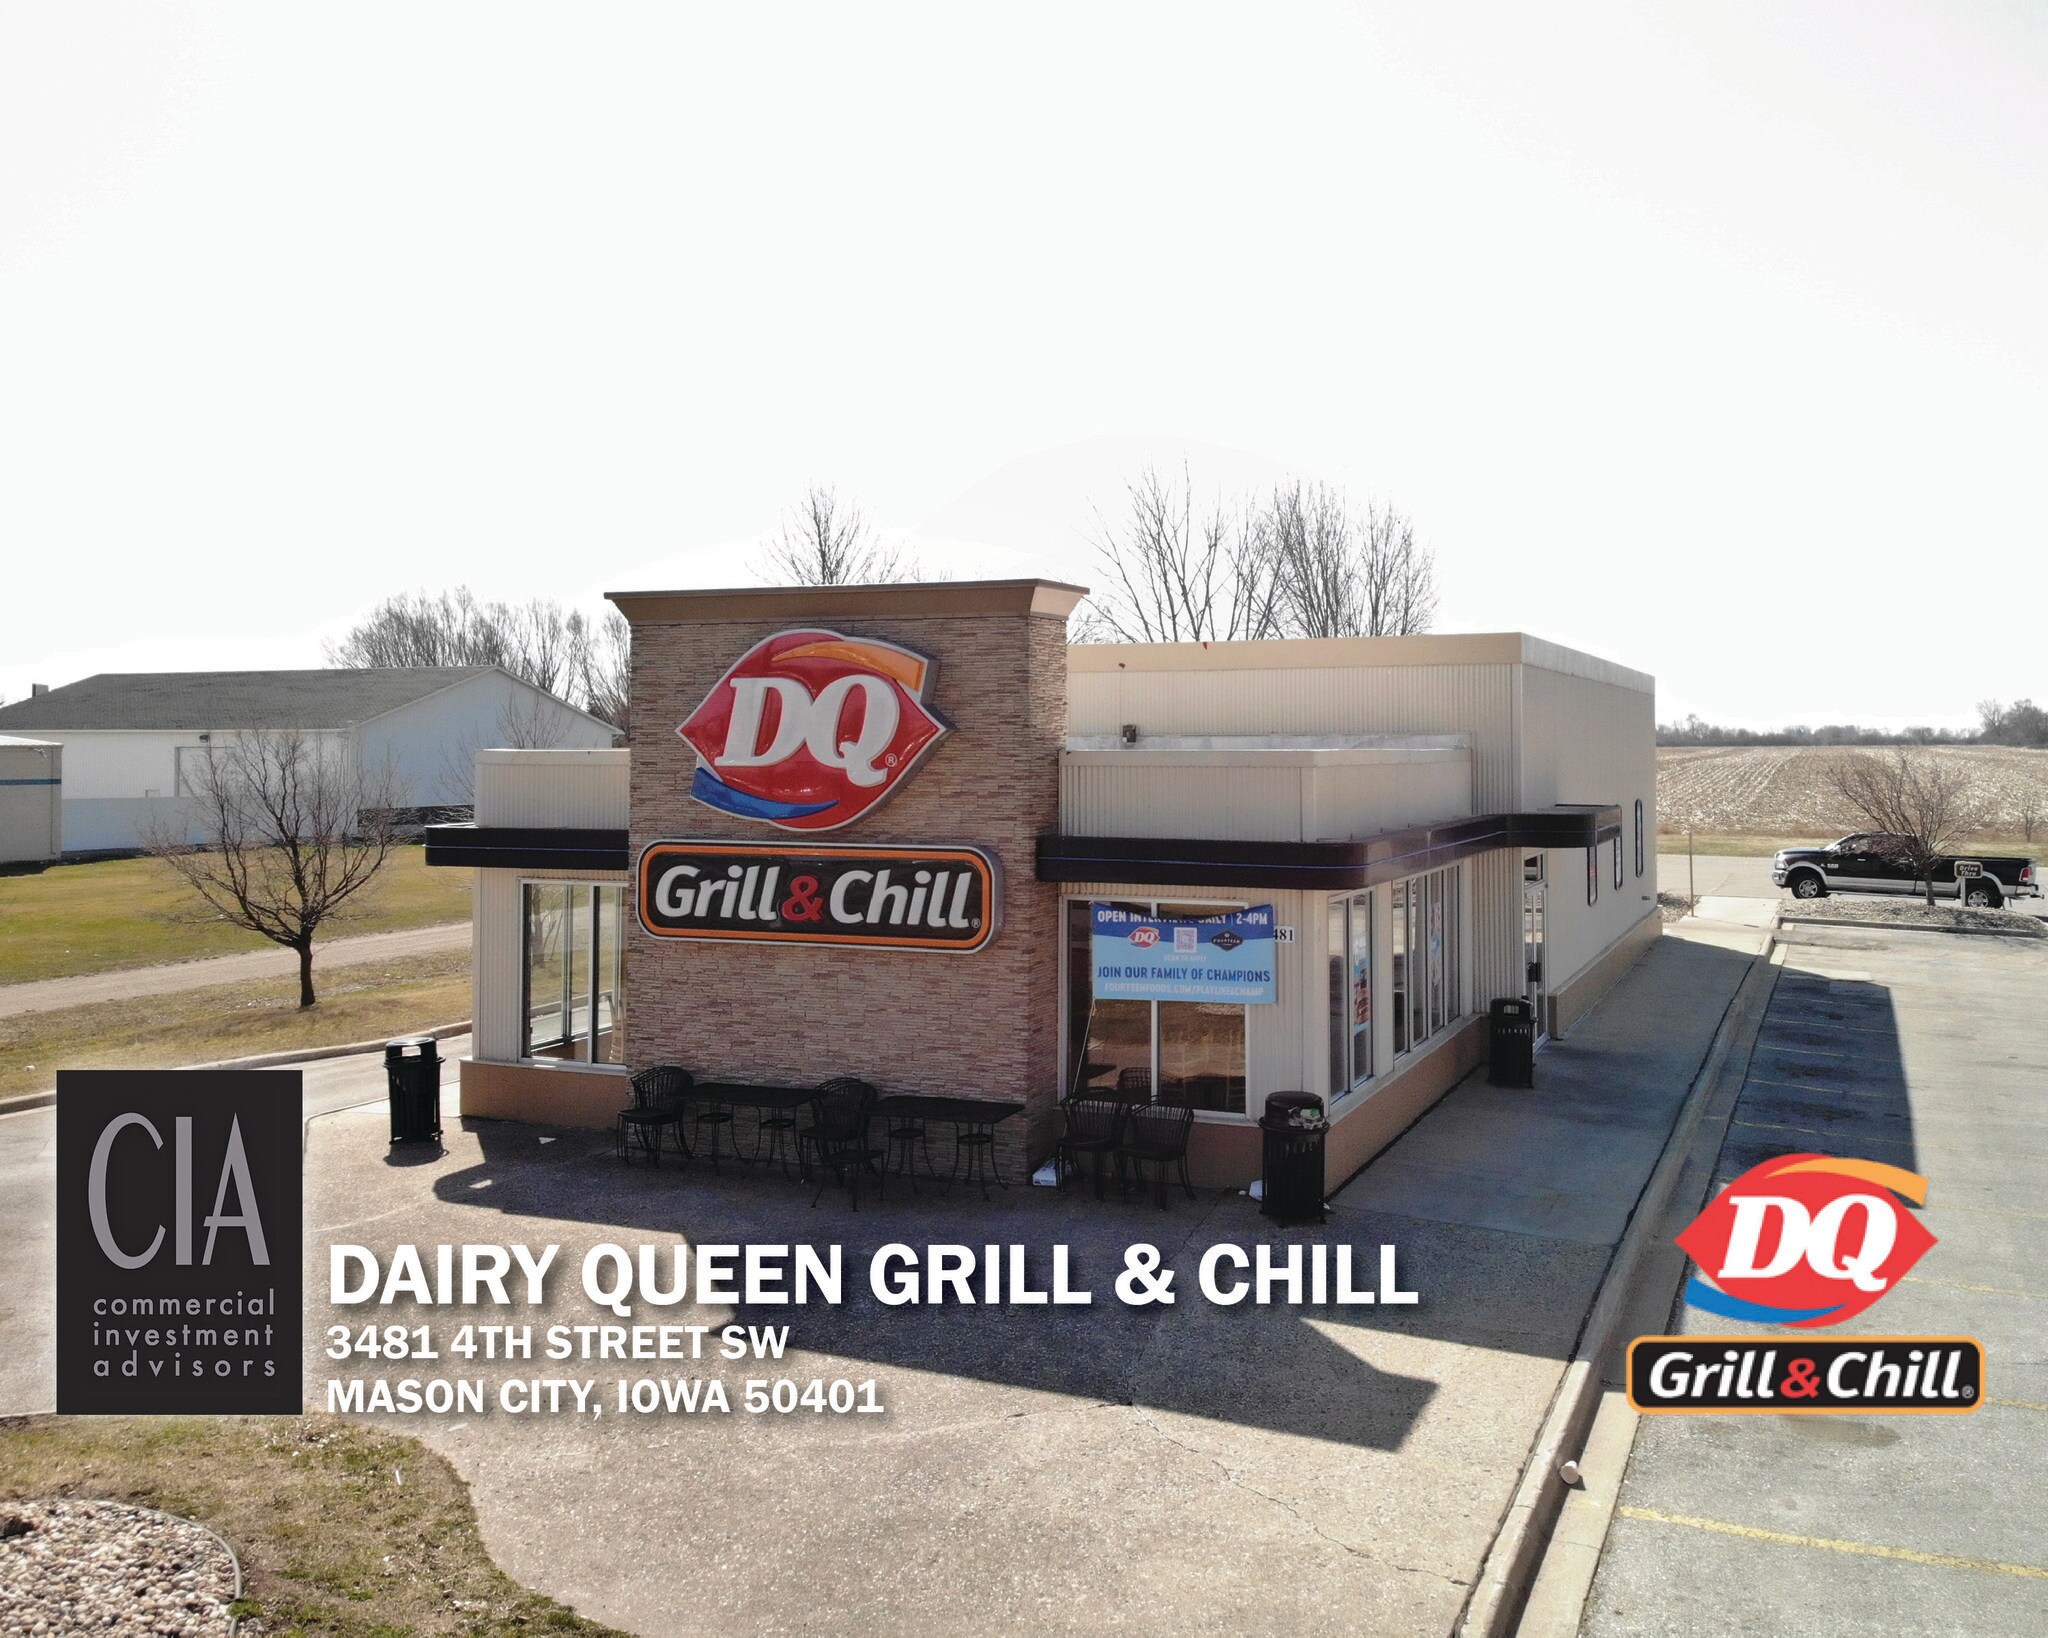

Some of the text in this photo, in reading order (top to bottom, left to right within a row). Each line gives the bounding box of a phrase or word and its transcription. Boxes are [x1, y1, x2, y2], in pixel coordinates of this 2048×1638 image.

[714, 675, 900, 787] DQ
[655, 864, 973, 928] Grill & Chill
[1097, 911, 1127, 923] OPEN
[1236, 912, 1268, 925] 2-4PM
[1134, 931, 1156, 944] DQ
[1097, 966, 1271, 982] JOIN OUR FAMILY OF CHAMPIONS
